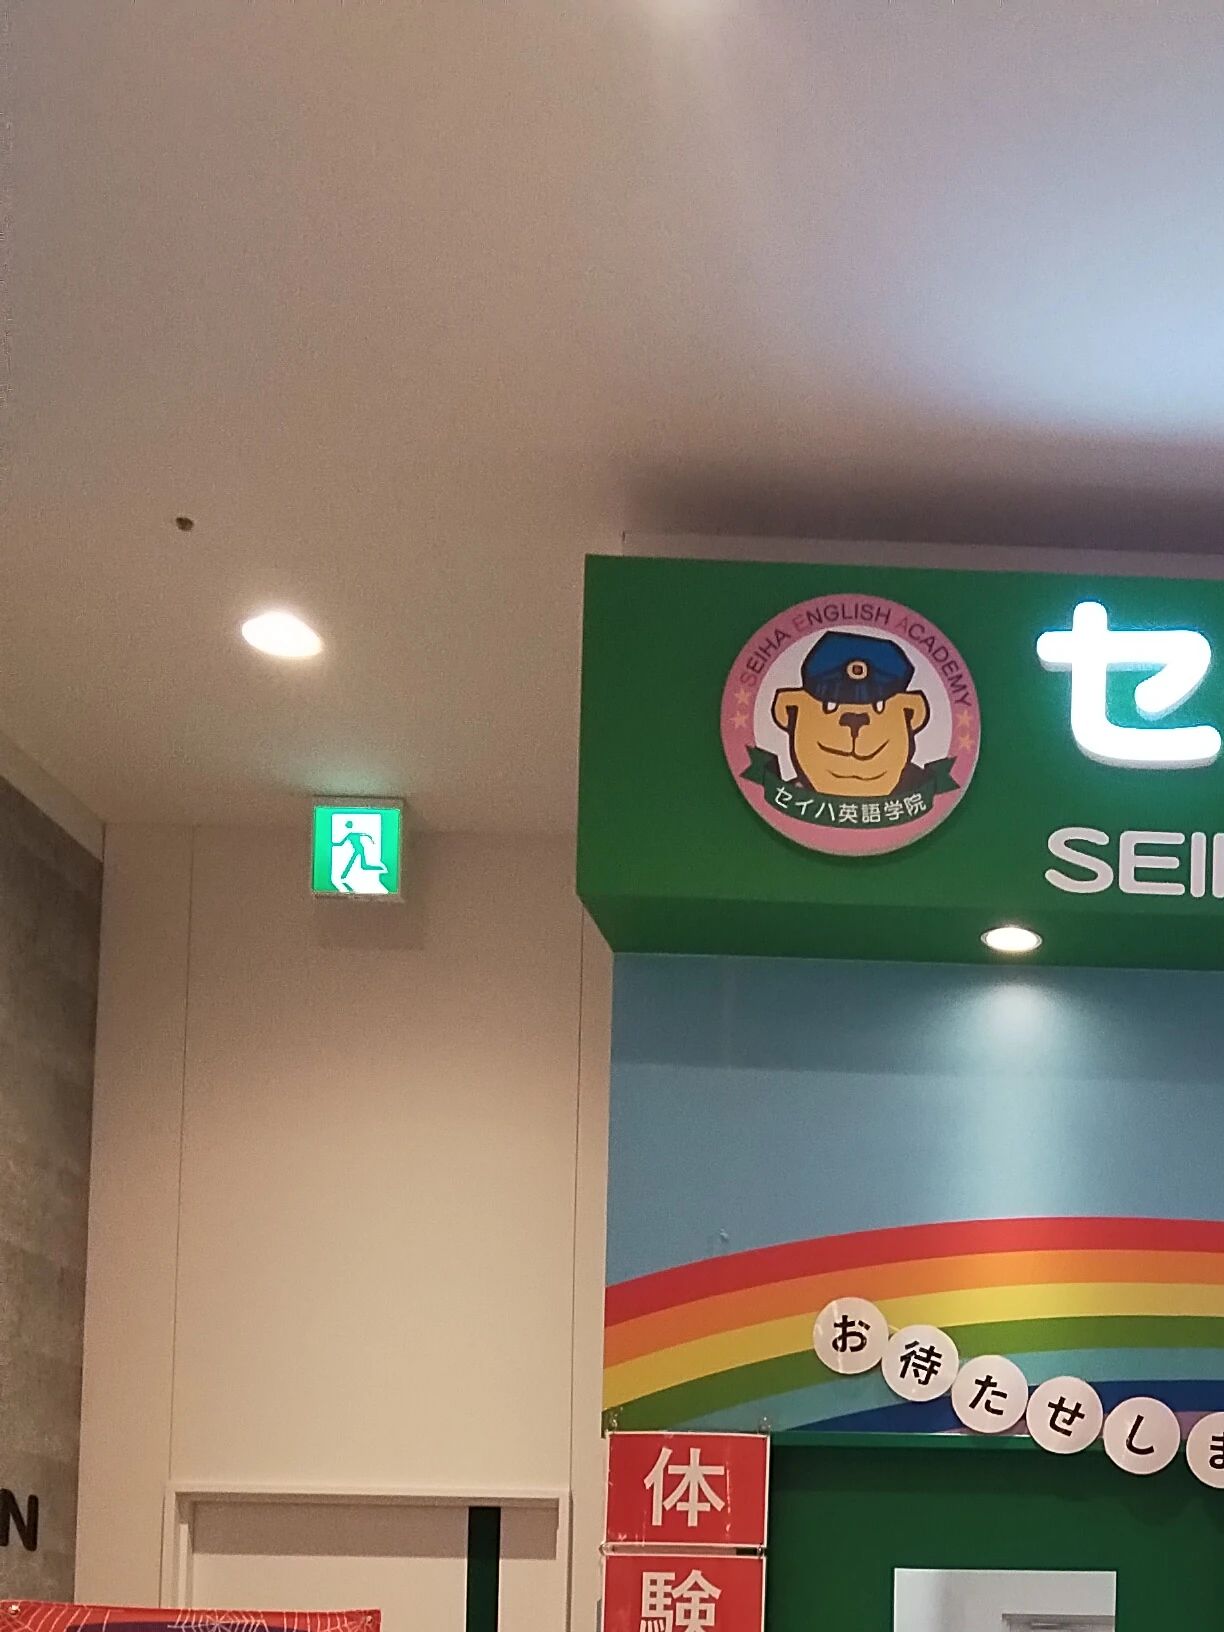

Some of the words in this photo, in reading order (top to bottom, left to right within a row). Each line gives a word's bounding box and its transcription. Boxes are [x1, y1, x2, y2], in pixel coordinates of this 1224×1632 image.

[740, 628, 791, 687] SEIHA
[793, 603, 892, 633] ENGLISH
[899, 617, 973, 707] ACADEMY
[774, 785, 927, 824] セイハ英語学院
